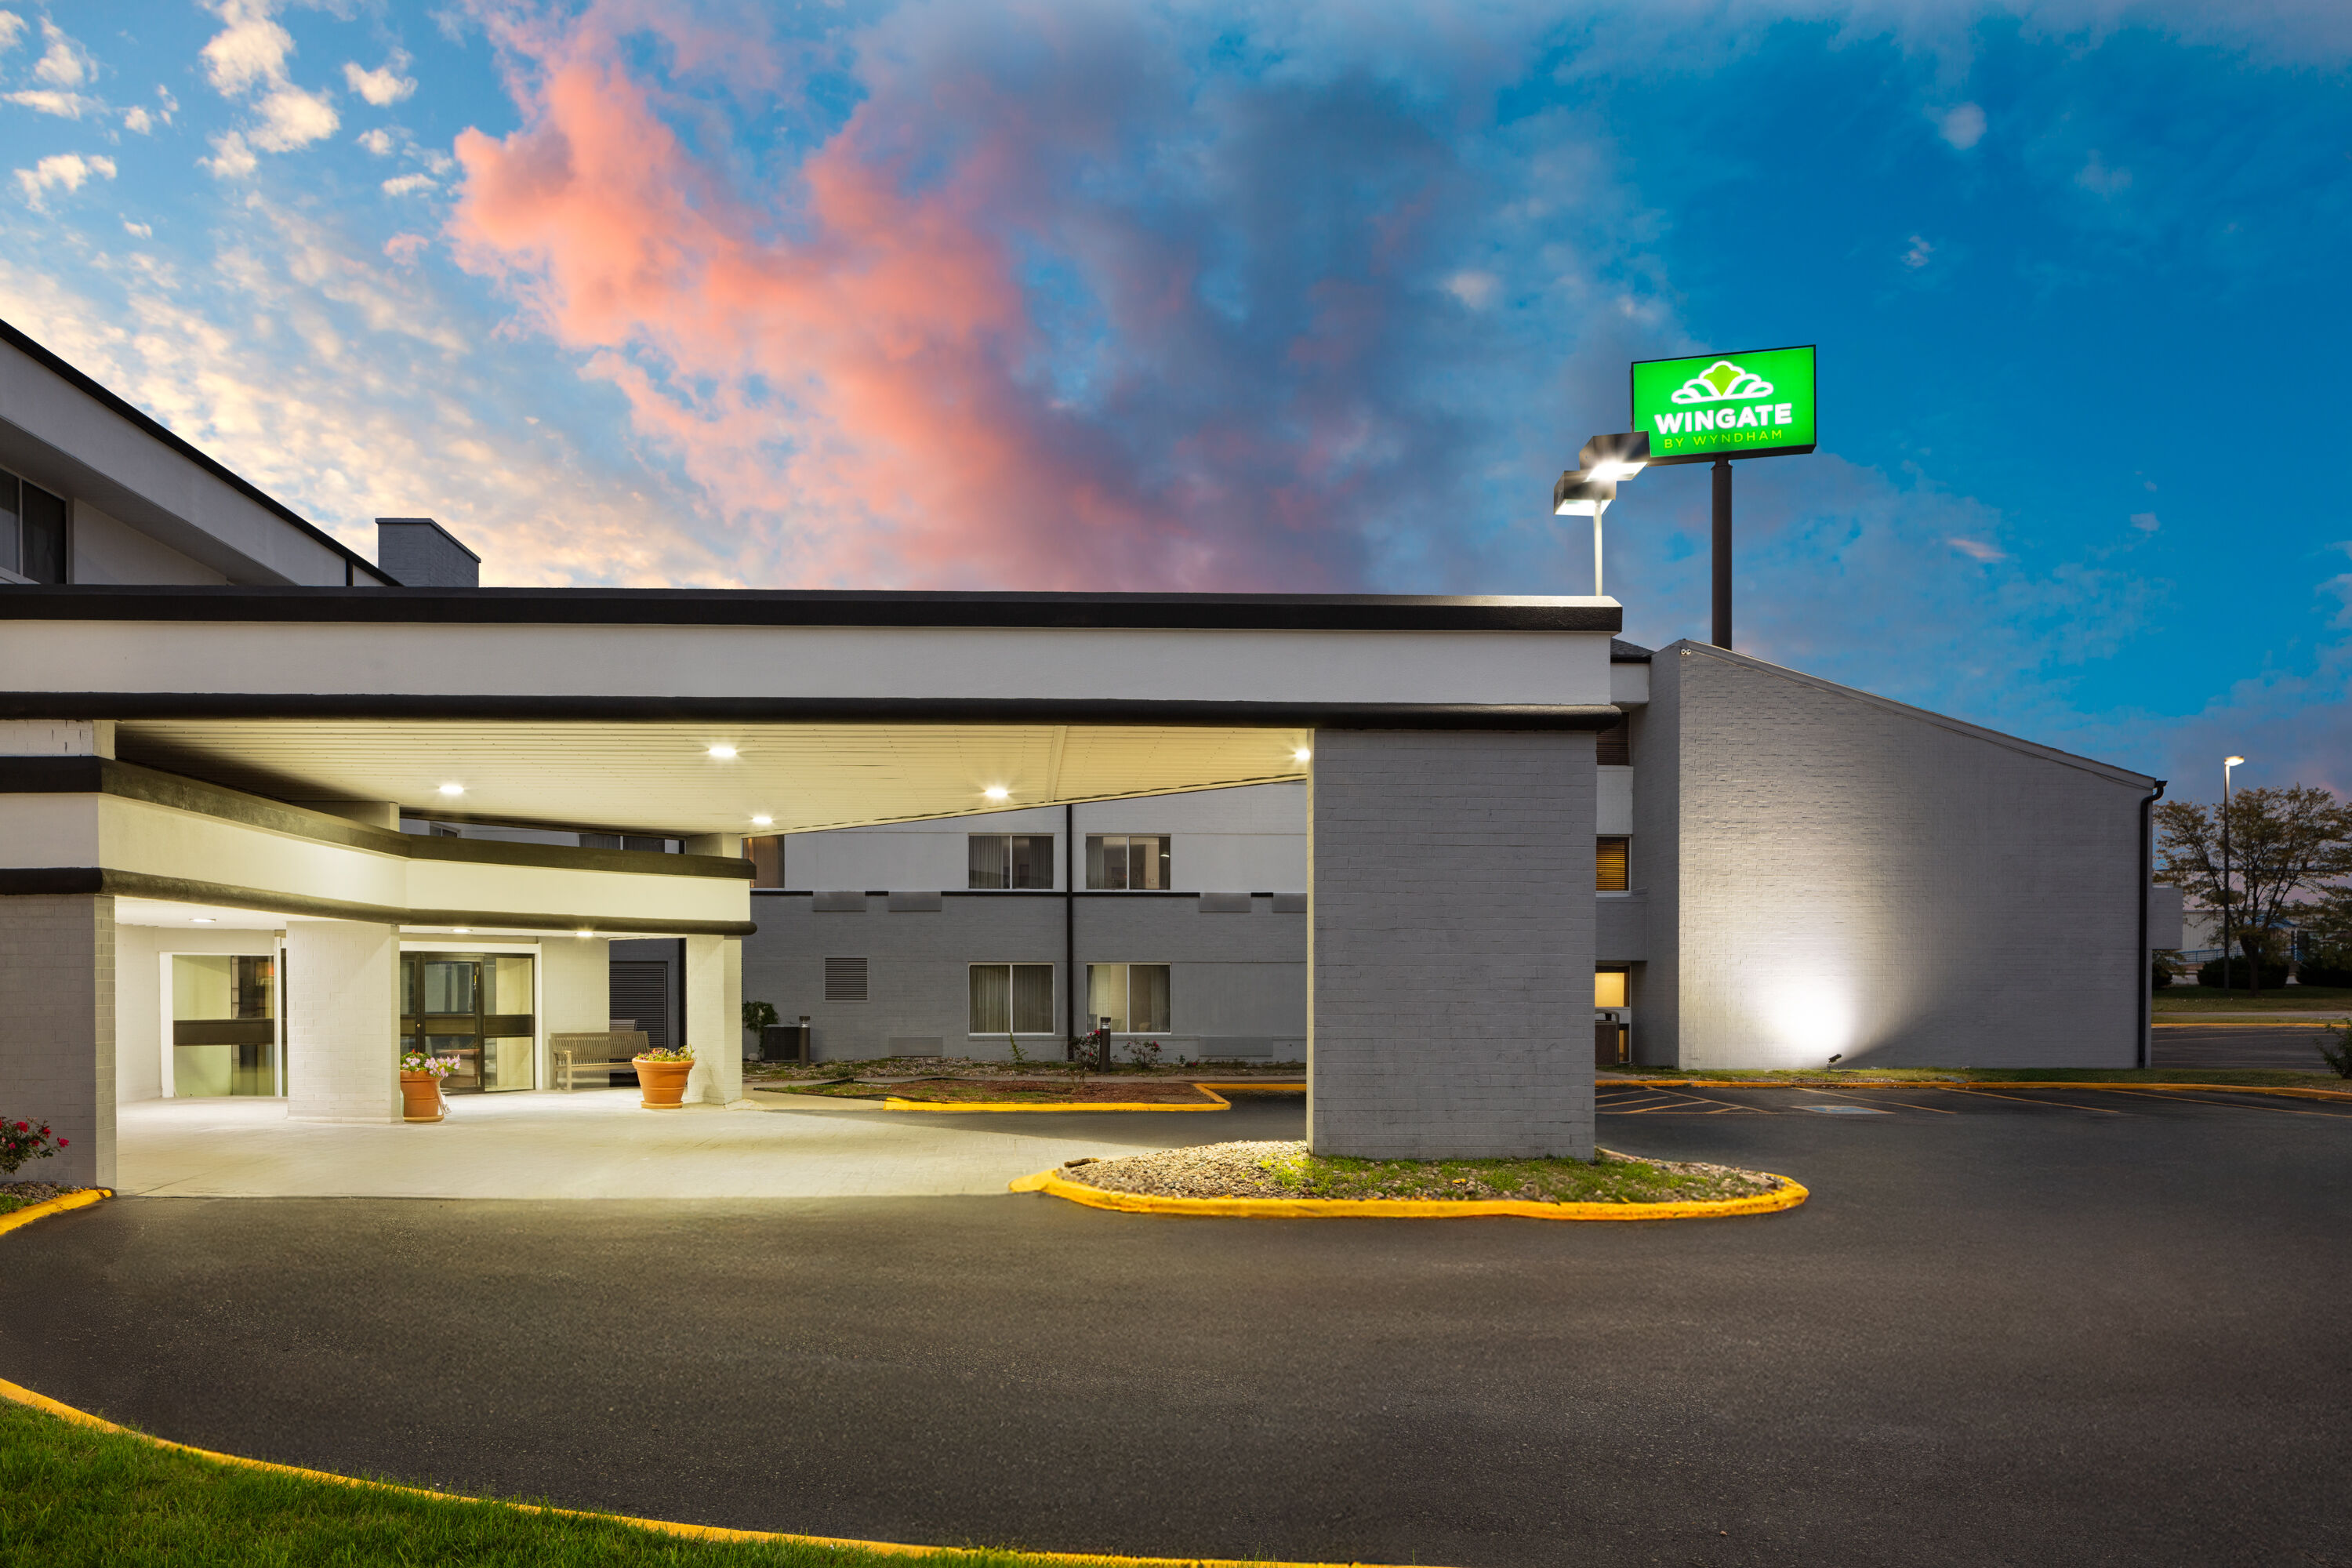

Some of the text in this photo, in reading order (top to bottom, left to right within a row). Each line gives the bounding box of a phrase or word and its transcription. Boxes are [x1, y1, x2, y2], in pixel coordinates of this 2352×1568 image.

[1654, 403, 1792, 434] WINGATE
[1664, 430, 1782, 448] BY WYNDHAM
